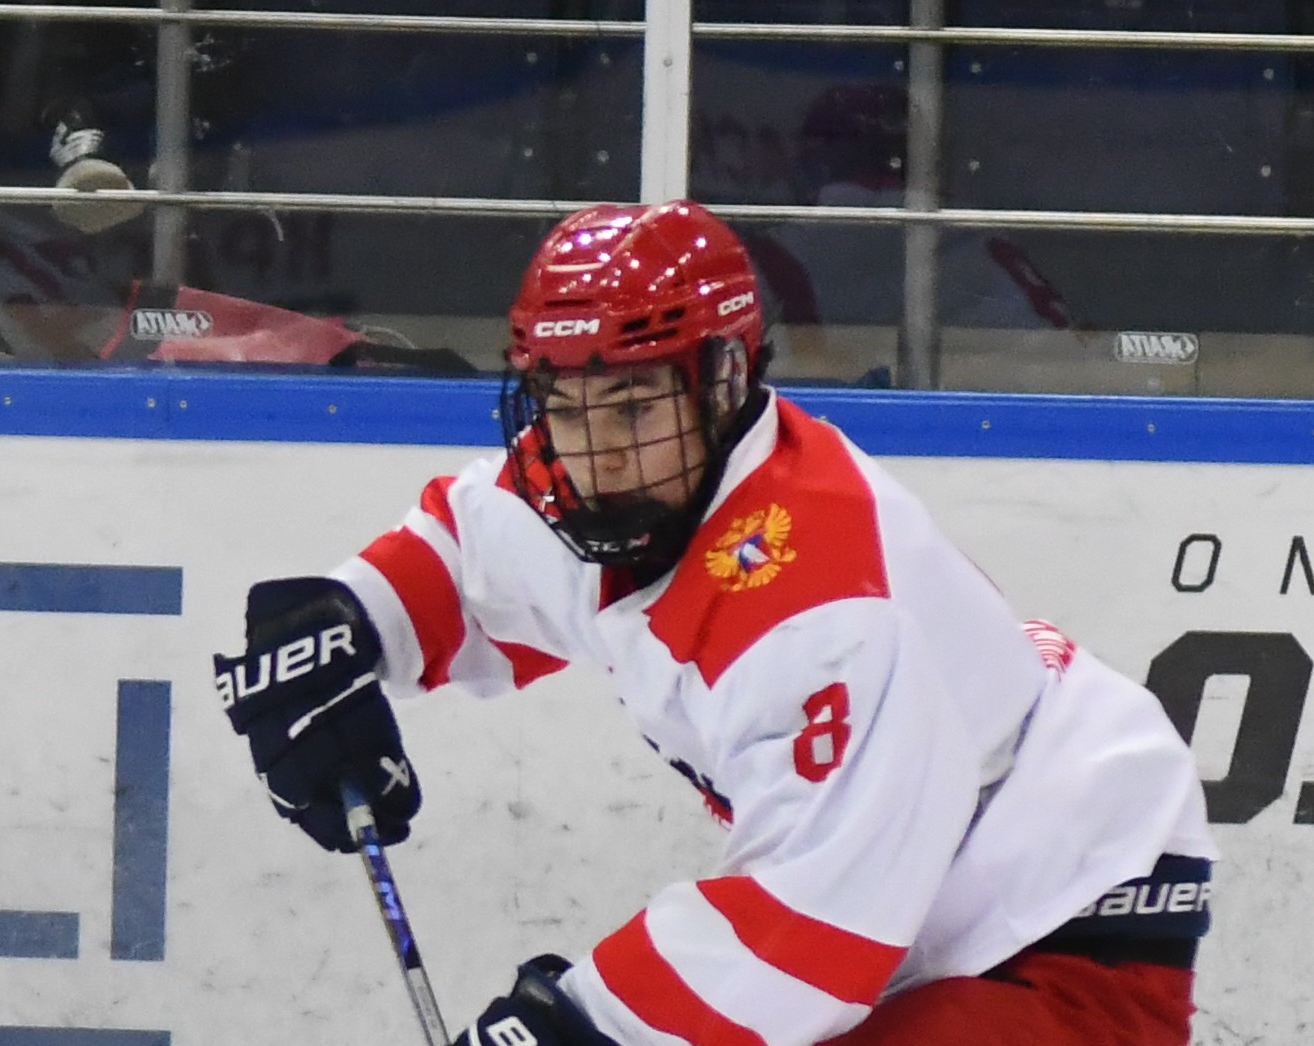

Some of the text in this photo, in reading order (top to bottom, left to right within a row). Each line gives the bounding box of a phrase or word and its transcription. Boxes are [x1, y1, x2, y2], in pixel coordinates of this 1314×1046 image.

[718, 291, 755, 316] CCM
[534, 318, 601, 338] CCM
[215, 623, 357, 711] AUER
[793, 682, 853, 784] 8
[1078, 881, 1212, 918] AUER
